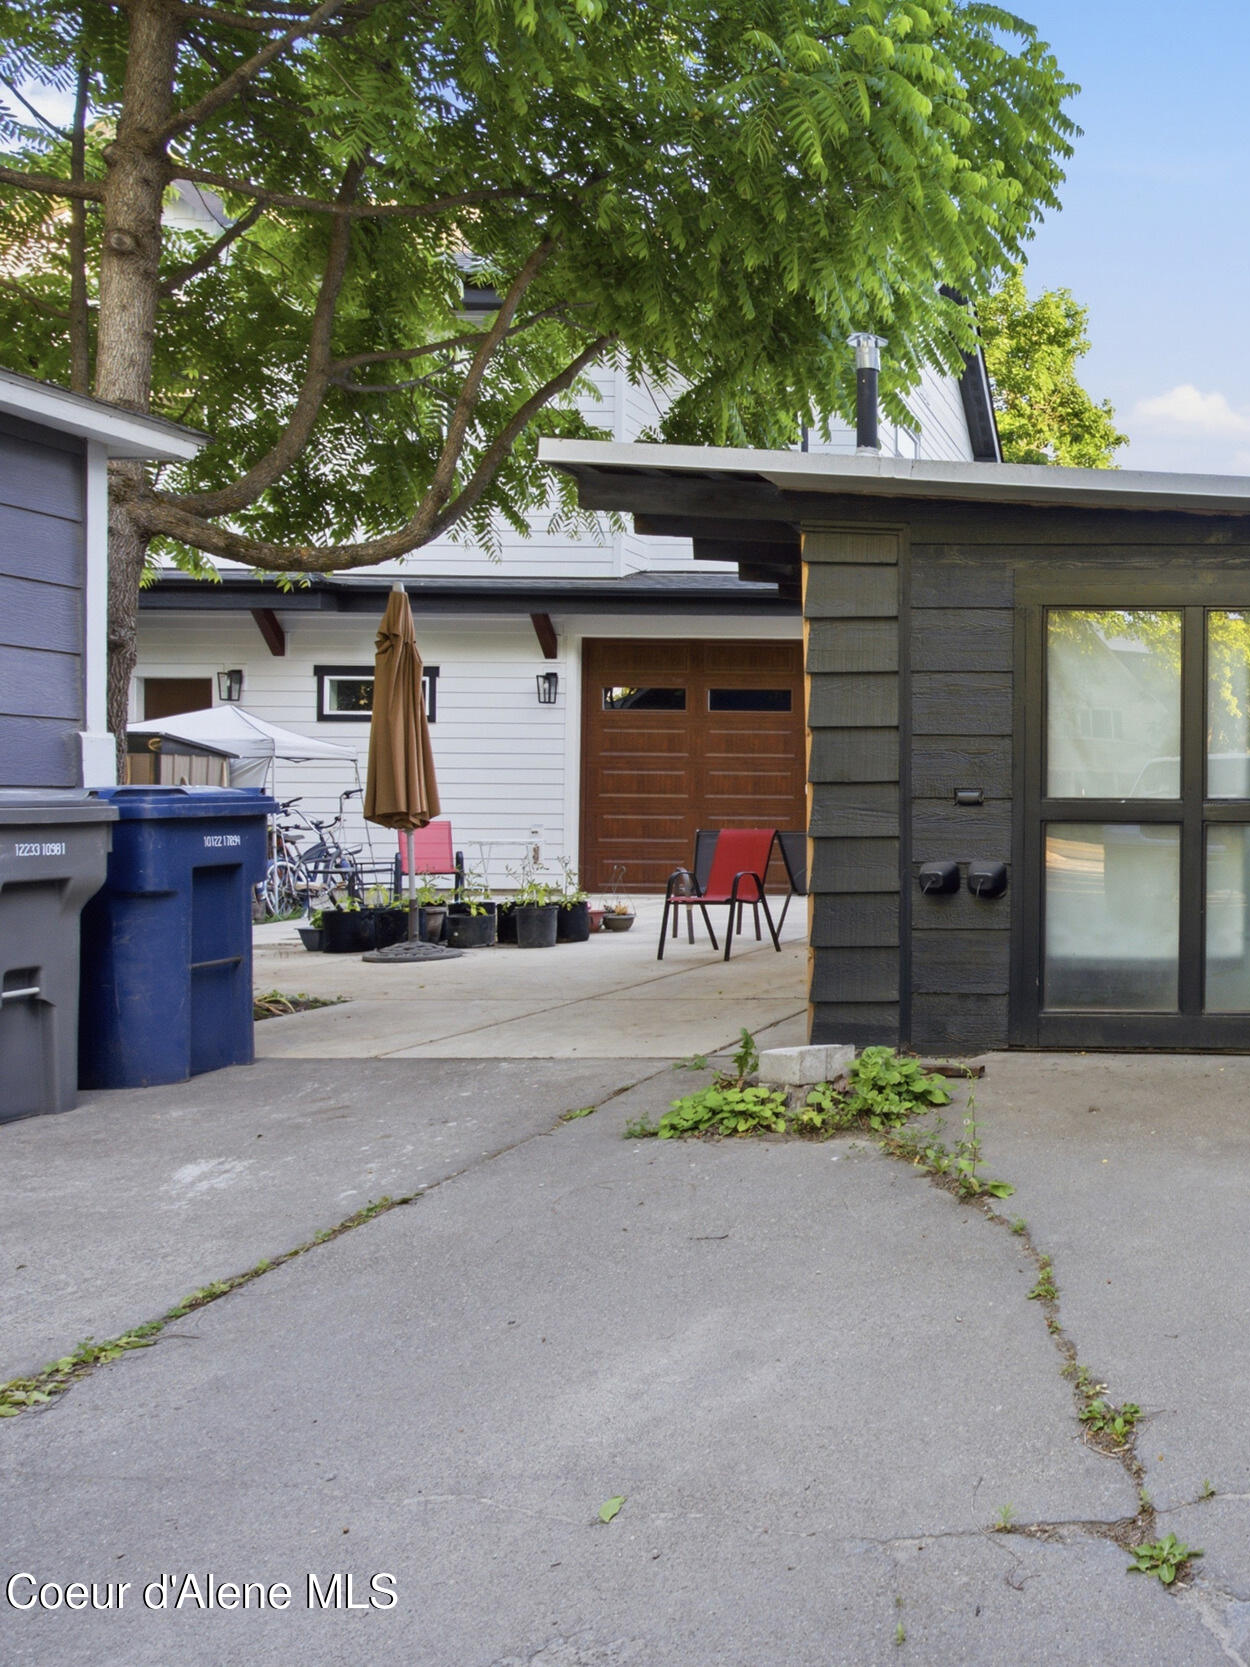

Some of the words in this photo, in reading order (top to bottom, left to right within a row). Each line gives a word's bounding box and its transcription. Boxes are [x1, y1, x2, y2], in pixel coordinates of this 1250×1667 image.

[203, 835, 222, 847] 10122
[15, 843, 40, 856] 12233
[42, 842, 65, 855] 10981
